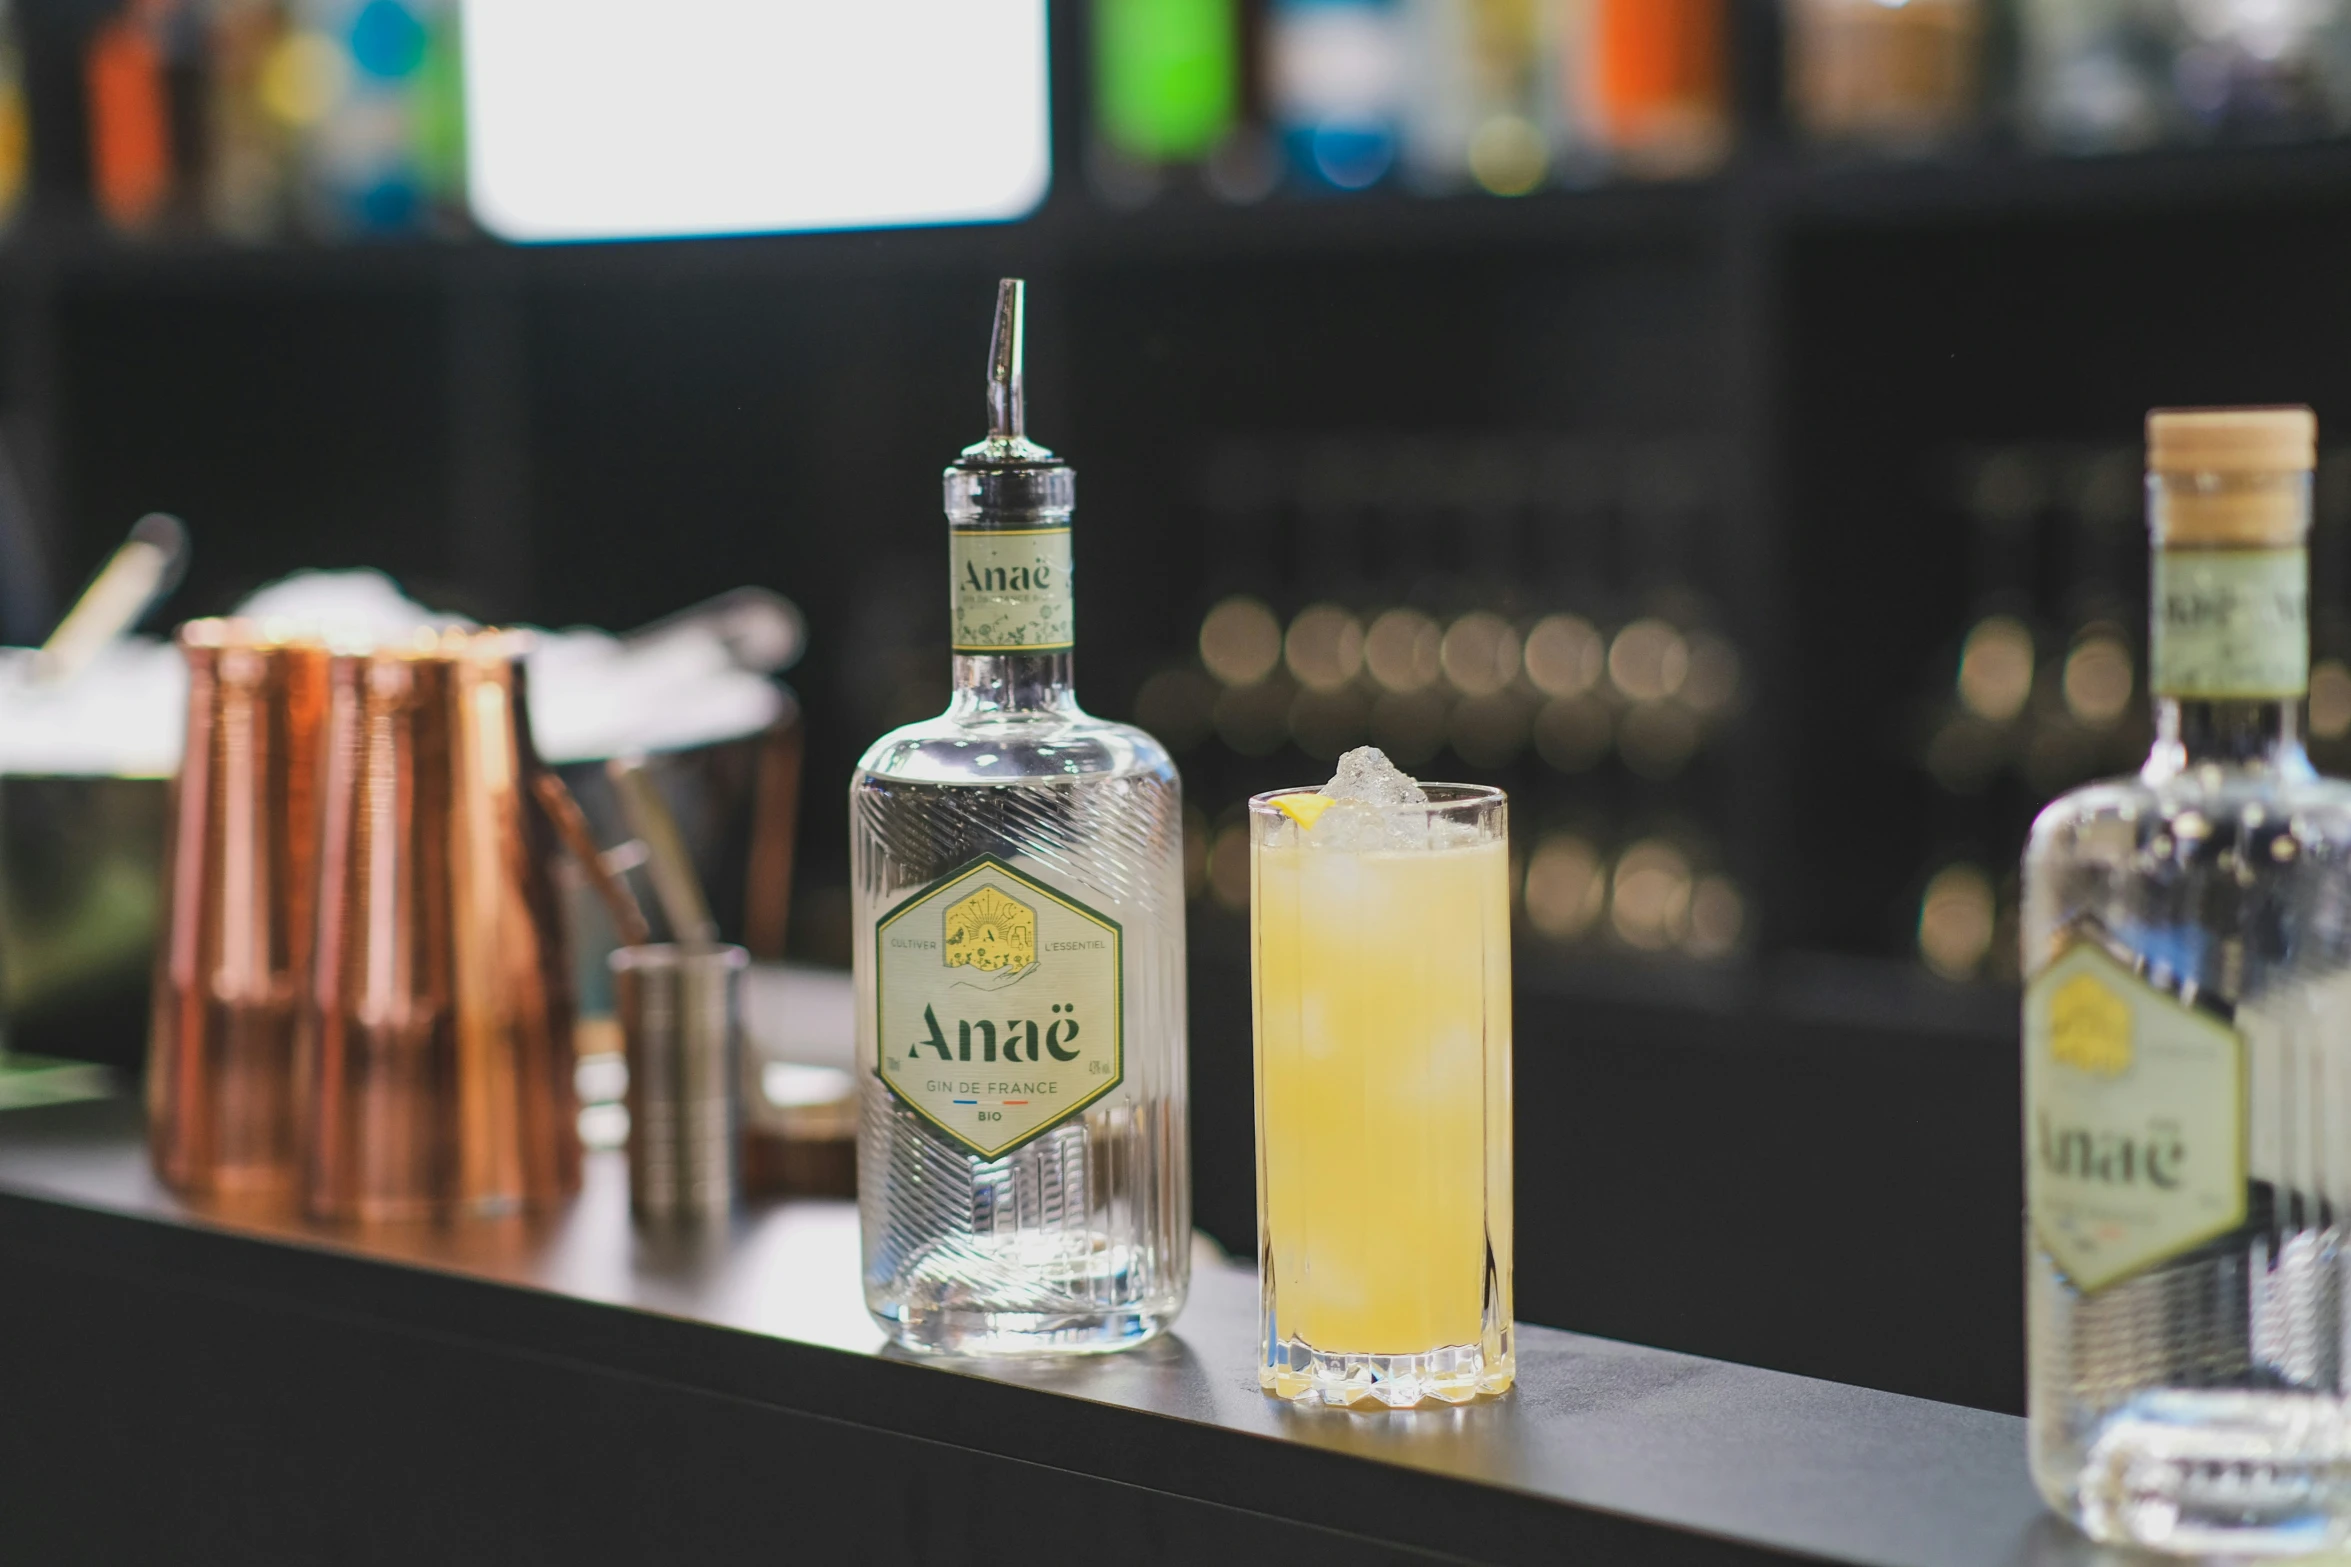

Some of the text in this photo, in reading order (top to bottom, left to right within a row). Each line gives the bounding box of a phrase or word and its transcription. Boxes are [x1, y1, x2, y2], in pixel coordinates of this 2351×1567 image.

[961, 557, 1051, 592] Anaë
[891, 938, 937, 950] CULTIVER
[1044, 940, 1106, 952] L'ESSENTIEL
[908, 1002, 1081, 1062] Anaë
[926, 1080, 1058, 1095] GIN DE FRANCE
[978, 1110, 1003, 1122] BIO
